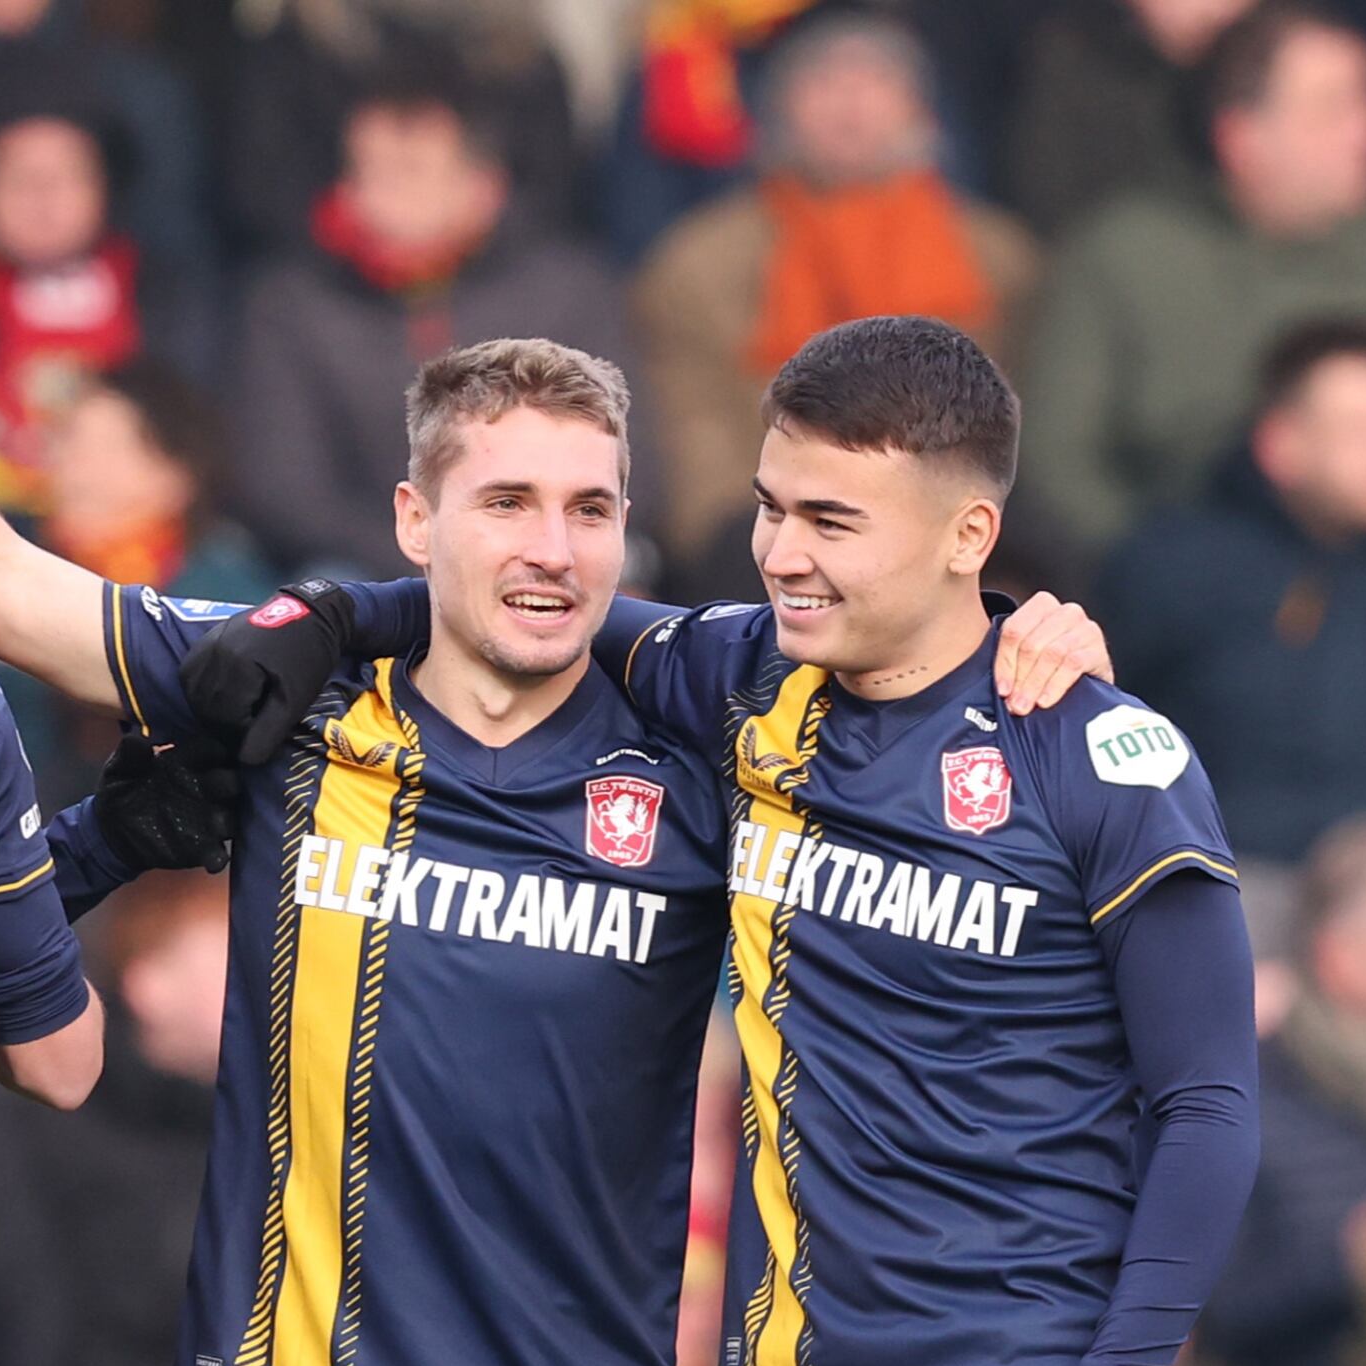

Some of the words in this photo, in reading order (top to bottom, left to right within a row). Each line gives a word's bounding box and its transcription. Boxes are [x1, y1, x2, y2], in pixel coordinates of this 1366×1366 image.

[1097, 726, 1175, 767] TOTO
[294, 833, 667, 964] ELEKTRAMAT
[730, 821, 1039, 958] ELEKTRAMAT
